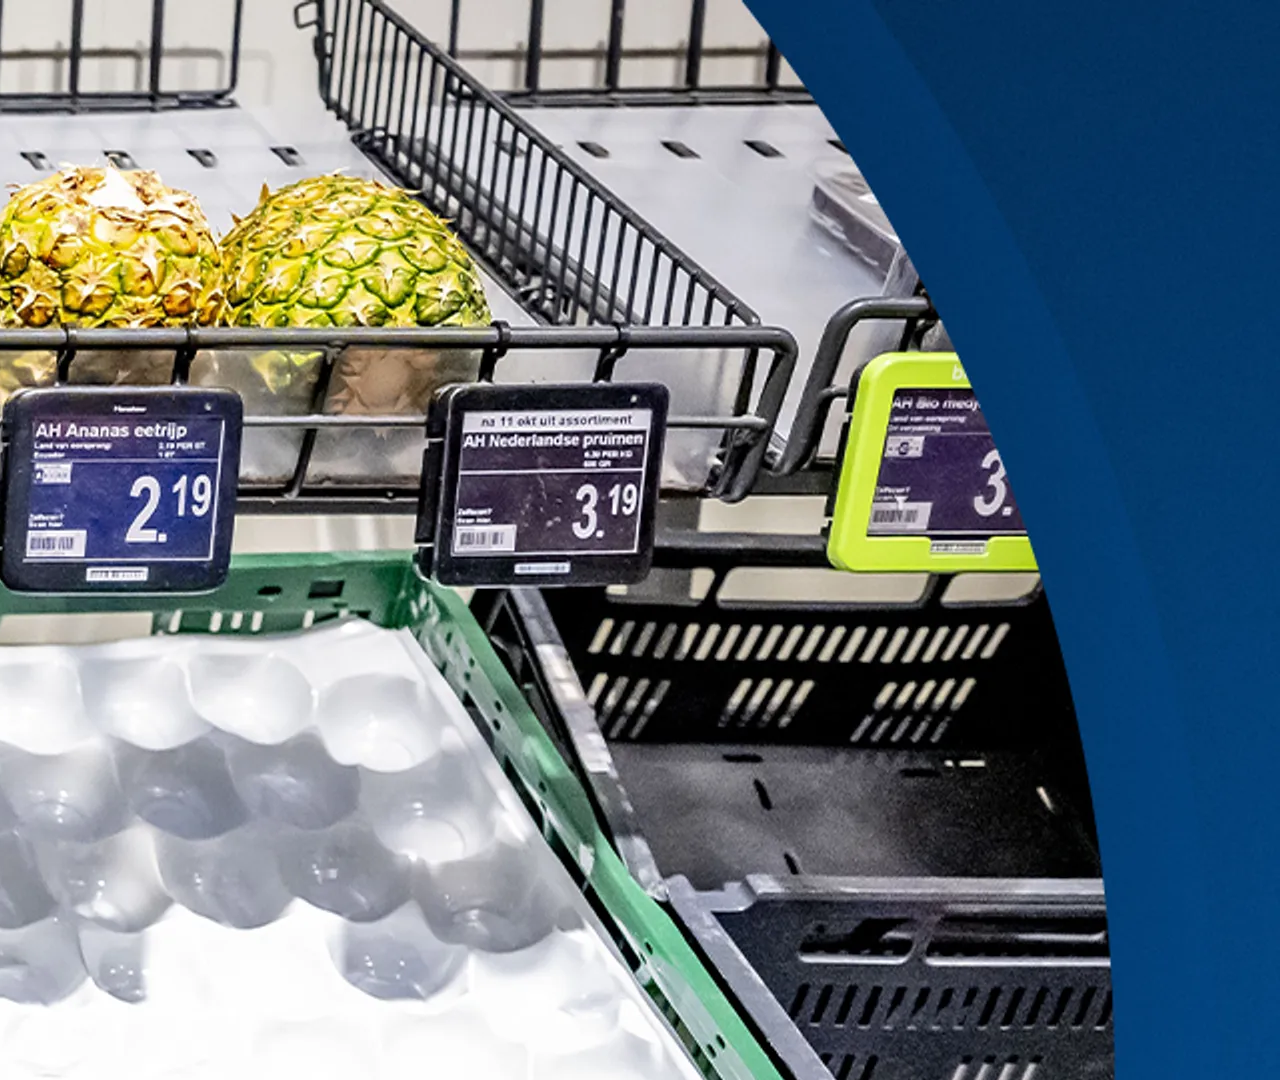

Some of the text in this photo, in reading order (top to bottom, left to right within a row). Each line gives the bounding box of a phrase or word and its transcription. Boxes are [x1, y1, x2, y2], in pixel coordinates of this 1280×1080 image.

[893, 397, 912, 408] AH
[917, 397, 939, 408] Bio
[482, 419, 495, 427] na
[518, 417, 536, 426] okt
[541, 416, 555, 425] uit
[559, 415, 632, 425] assortiment
[35, 423, 187, 439] AH Ananas eetrijp
[463, 434, 643, 448] AH Nederlandse pruimen
